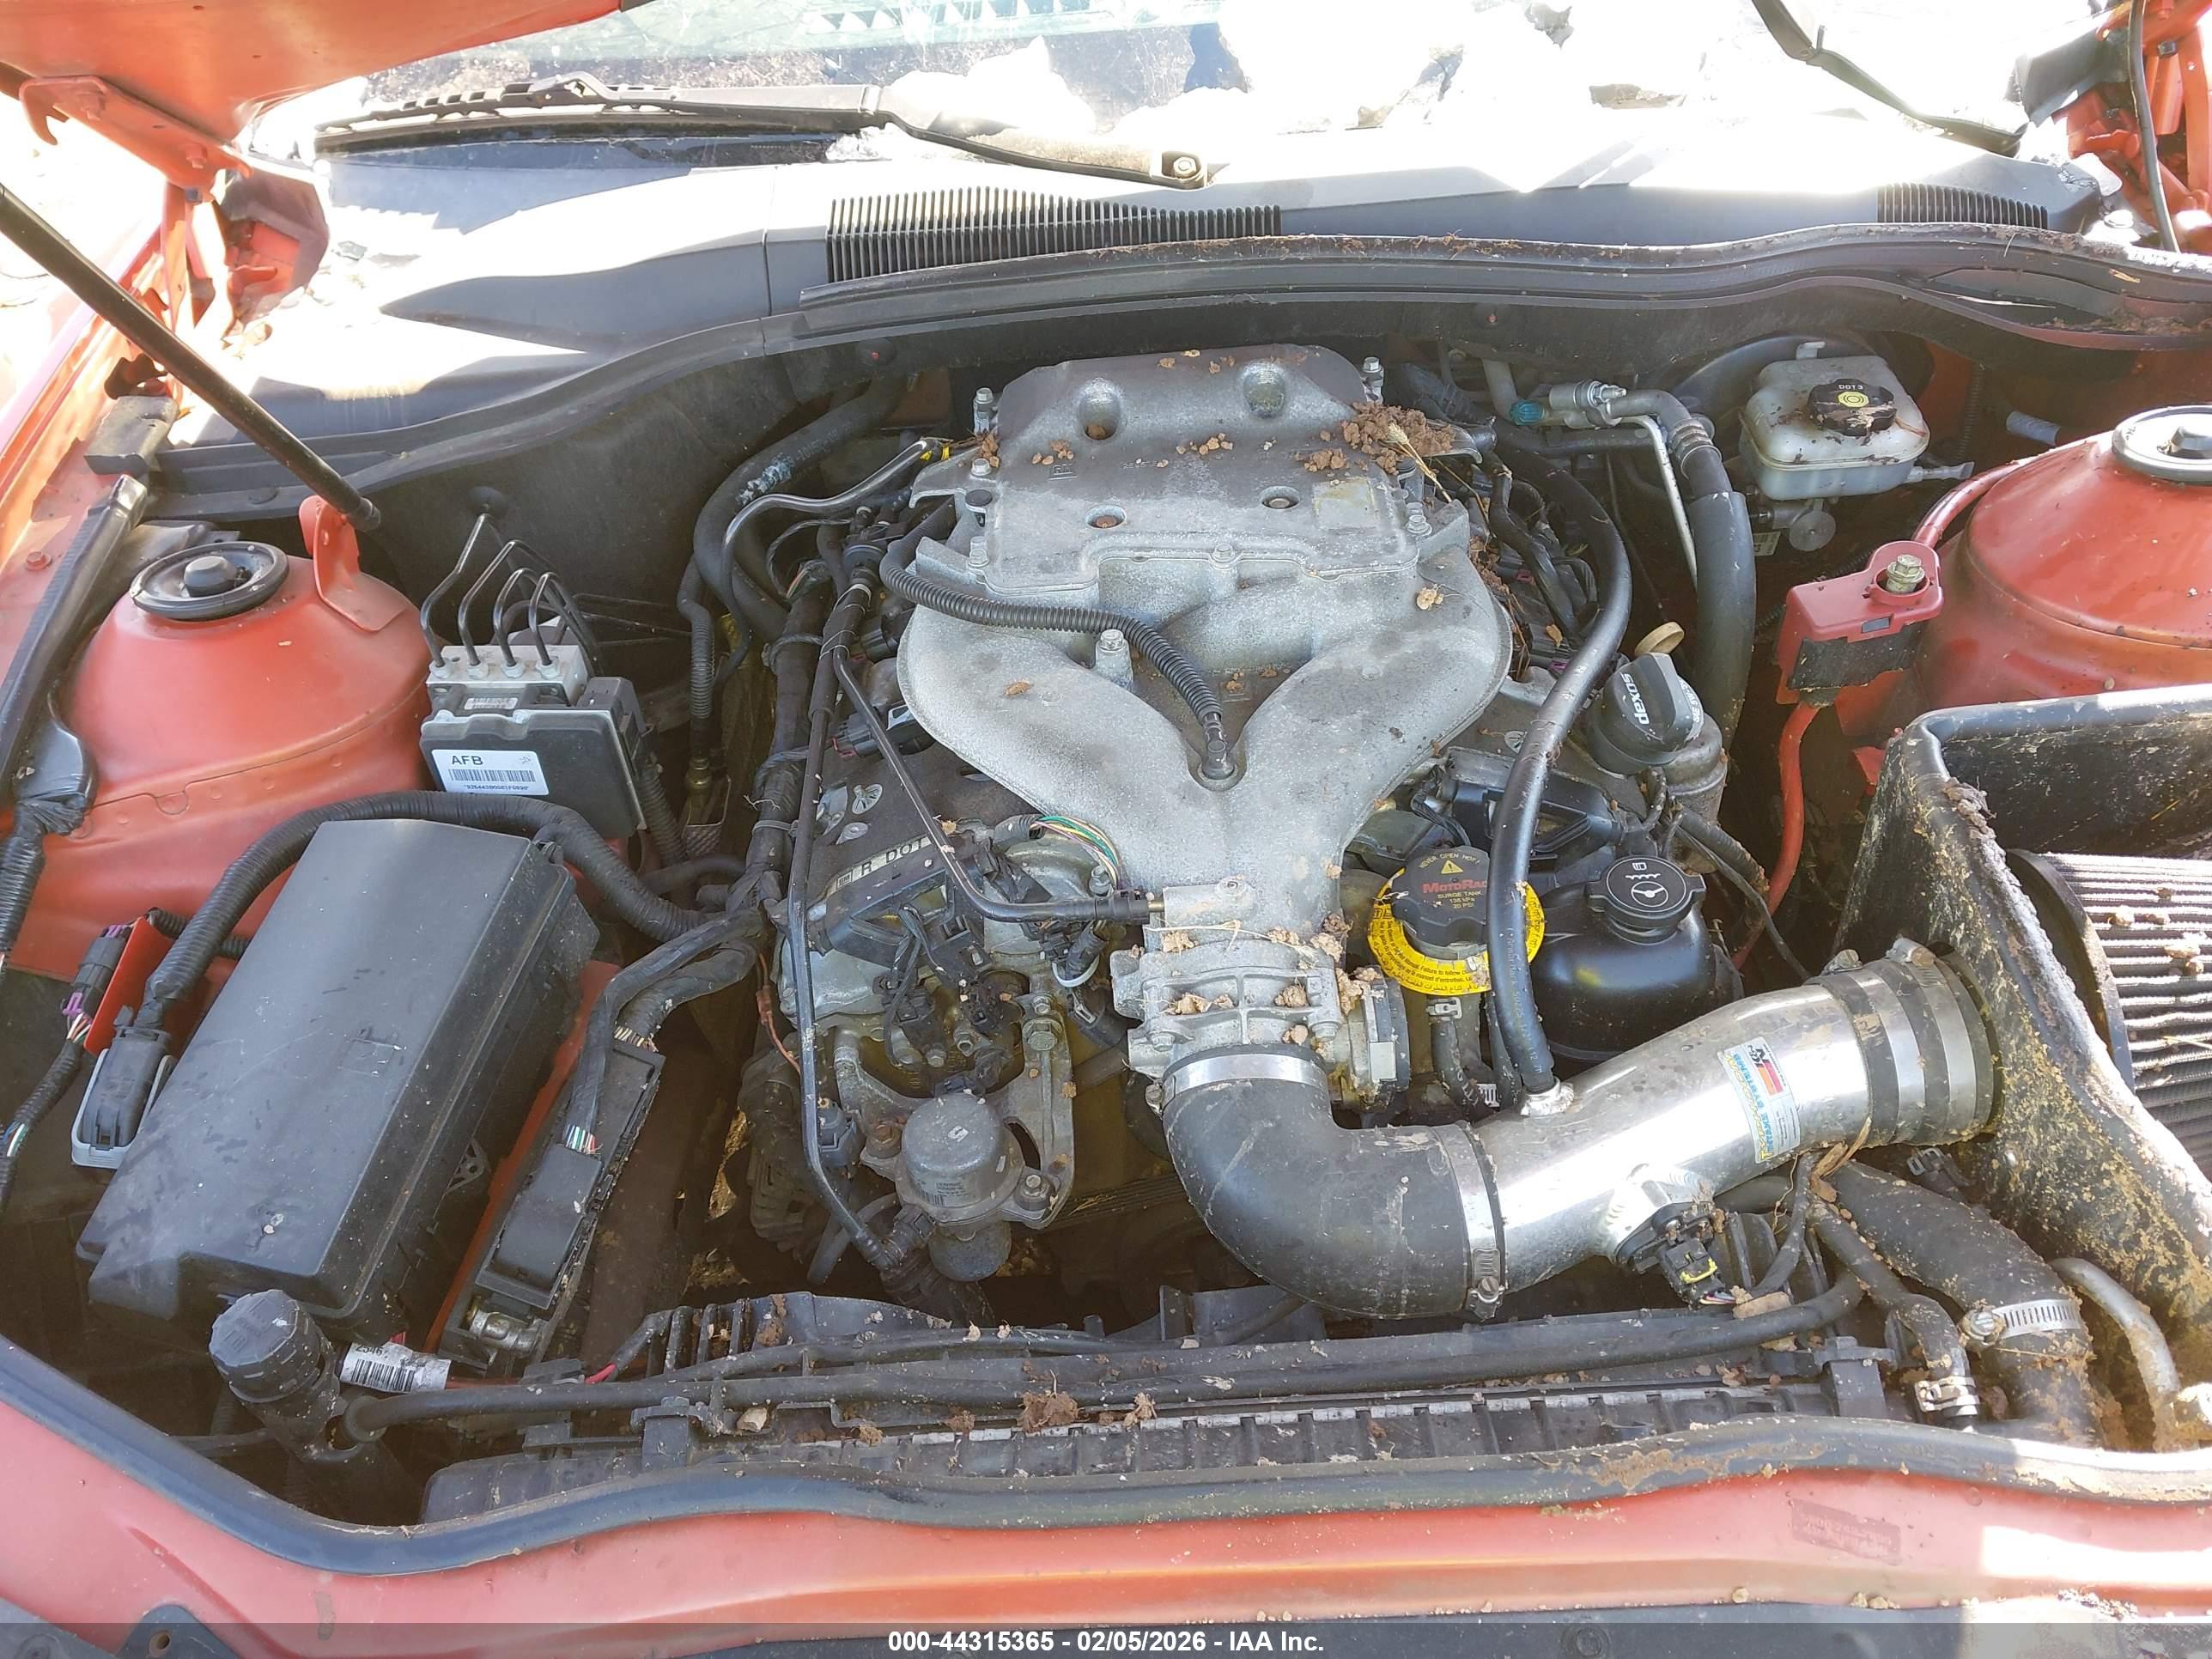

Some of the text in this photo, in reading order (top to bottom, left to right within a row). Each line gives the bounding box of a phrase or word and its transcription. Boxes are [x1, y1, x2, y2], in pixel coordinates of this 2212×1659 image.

[1620, 672, 1650, 725] dexos
[1692, 706, 1700, 722] SAE
[452, 756, 483, 765] AFB
